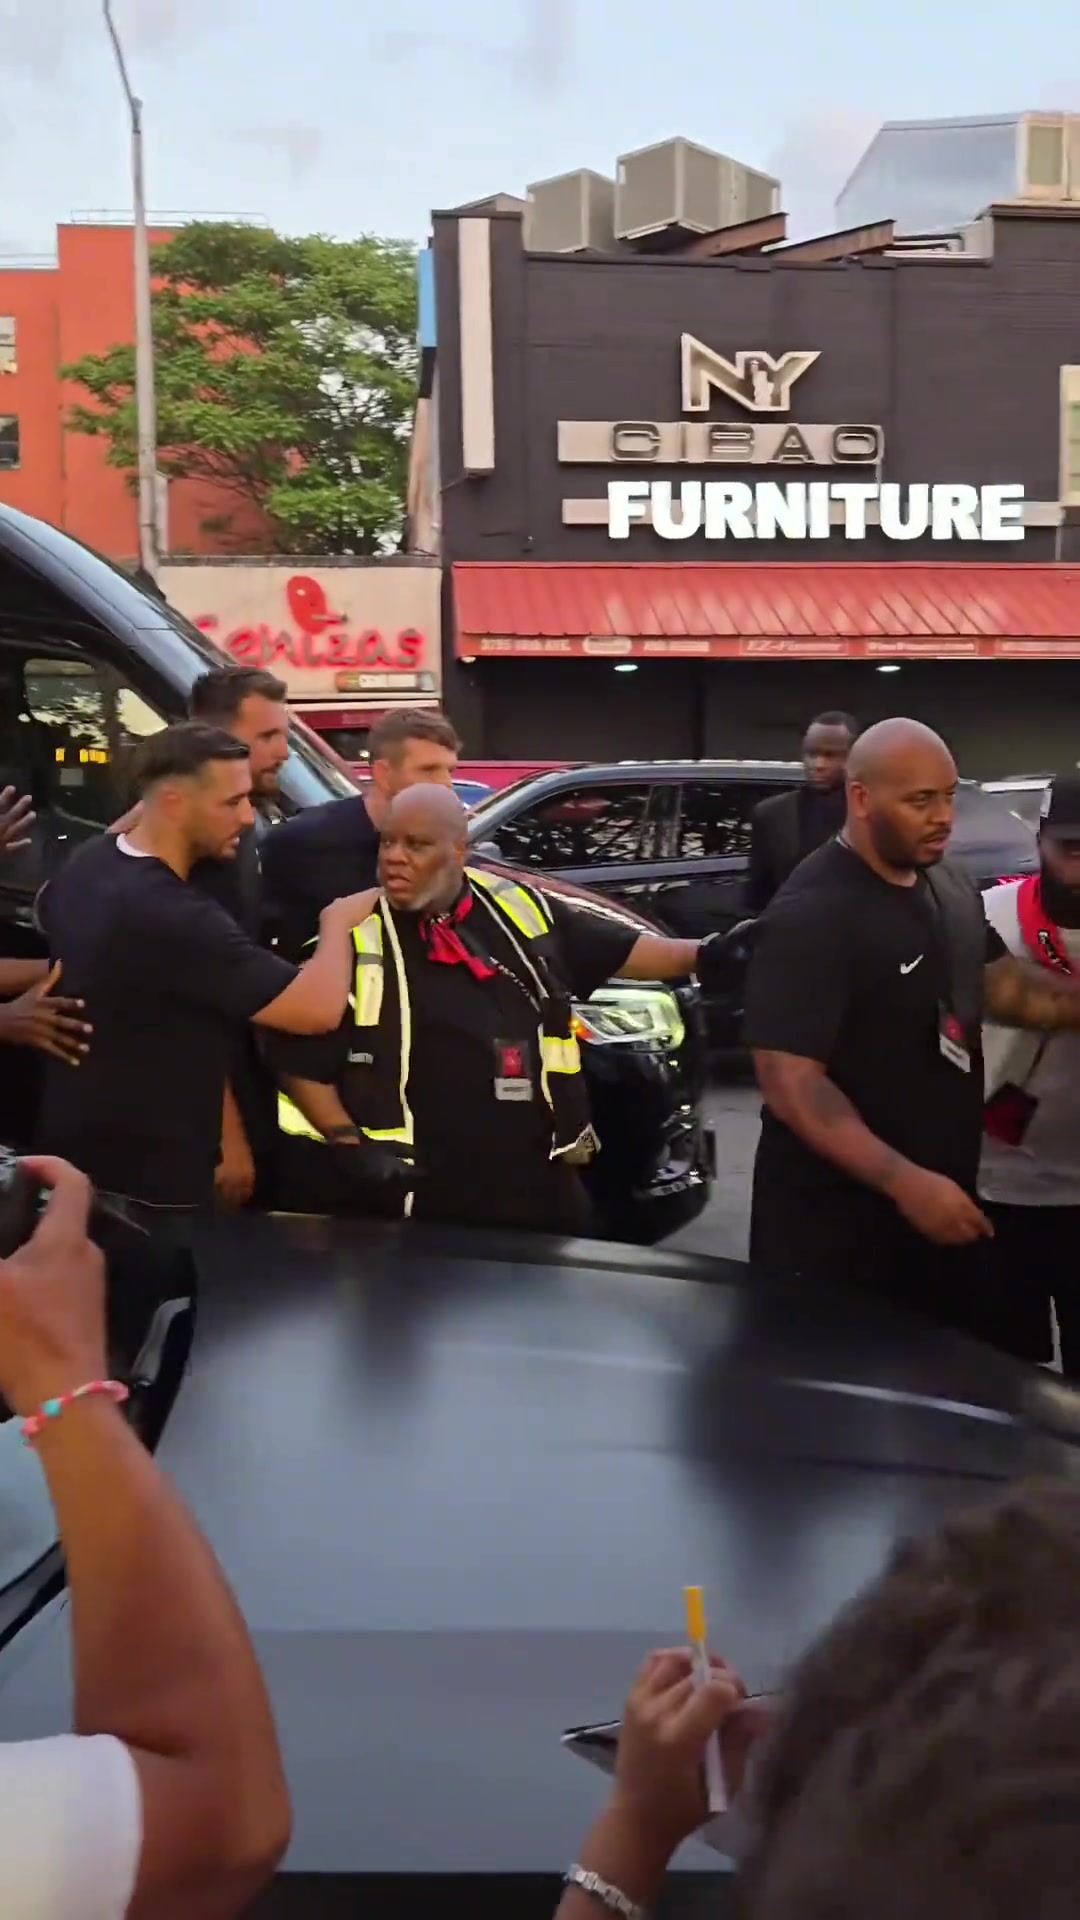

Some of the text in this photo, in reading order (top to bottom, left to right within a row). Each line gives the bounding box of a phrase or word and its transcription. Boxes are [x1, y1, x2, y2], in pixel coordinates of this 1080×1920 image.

[681, 332, 823, 411] NY
[611, 421, 883, 464] CIBAO
[608, 481, 1025, 540] FURNITURE
